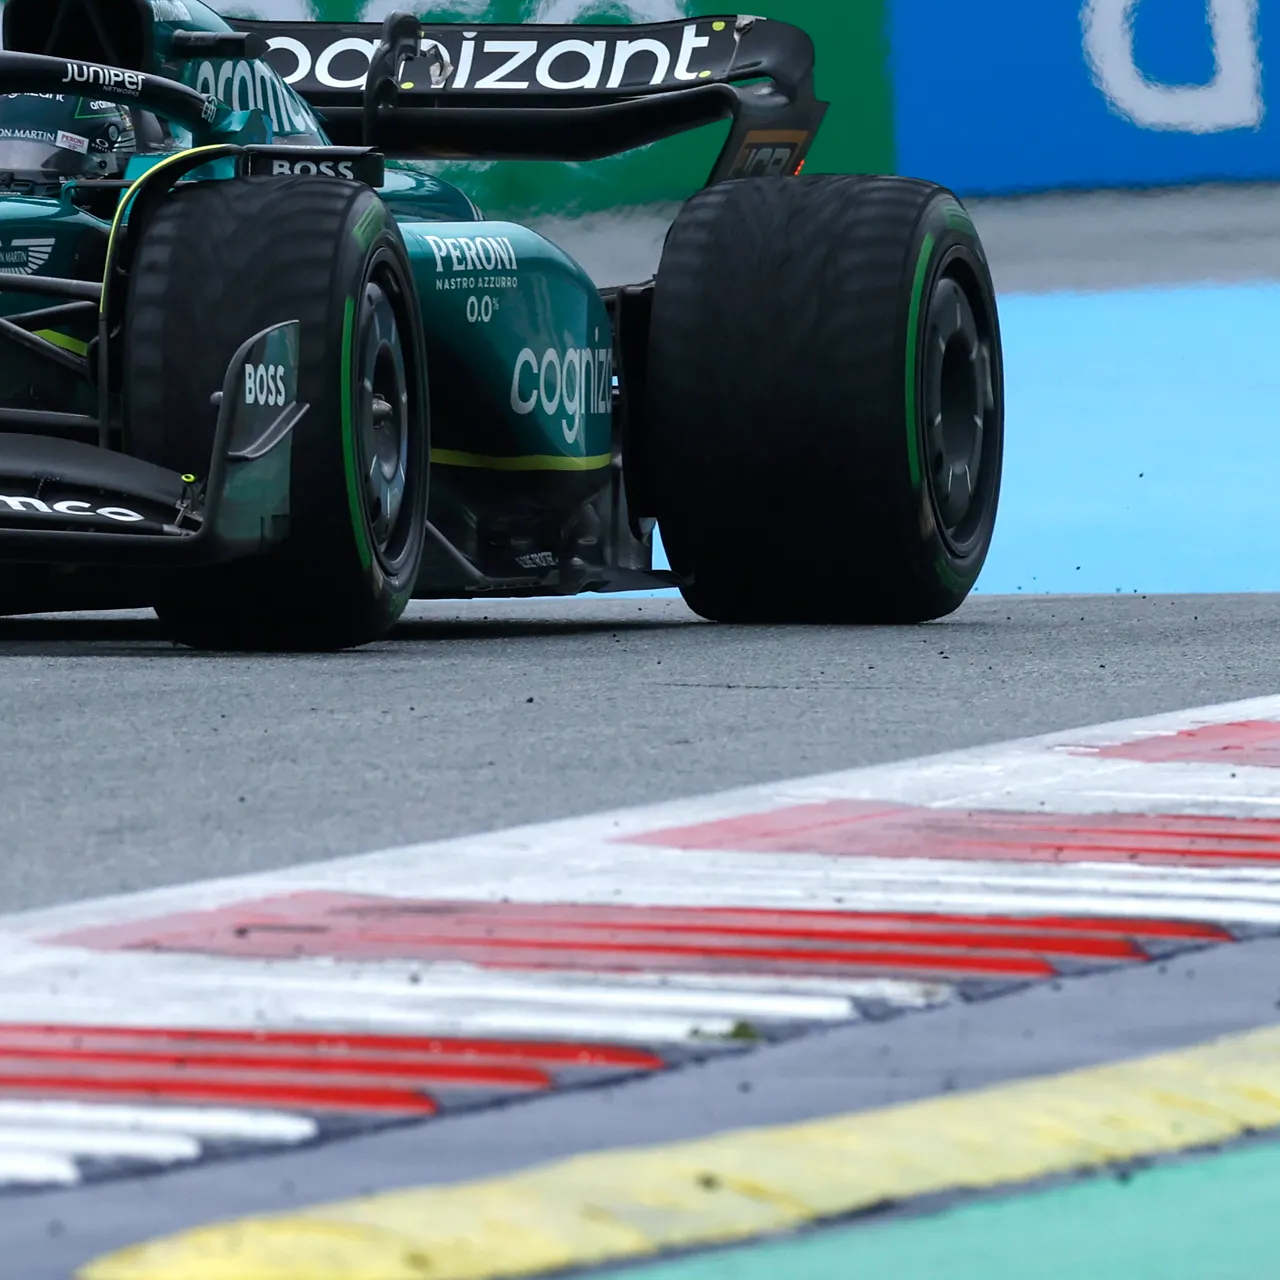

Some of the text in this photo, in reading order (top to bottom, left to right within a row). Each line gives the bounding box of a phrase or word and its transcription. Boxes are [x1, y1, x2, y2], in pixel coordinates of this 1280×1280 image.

[103, 85, 139, 97] NETWORKS
[14, 128, 55, 141] MARTIN
[5, 250, 27, 263] MARTIN
[423, 235, 518, 272] PERONI
[436, 276, 517, 290] NASTRO AZZURRO
[245, 362, 286, 407] BOSS
